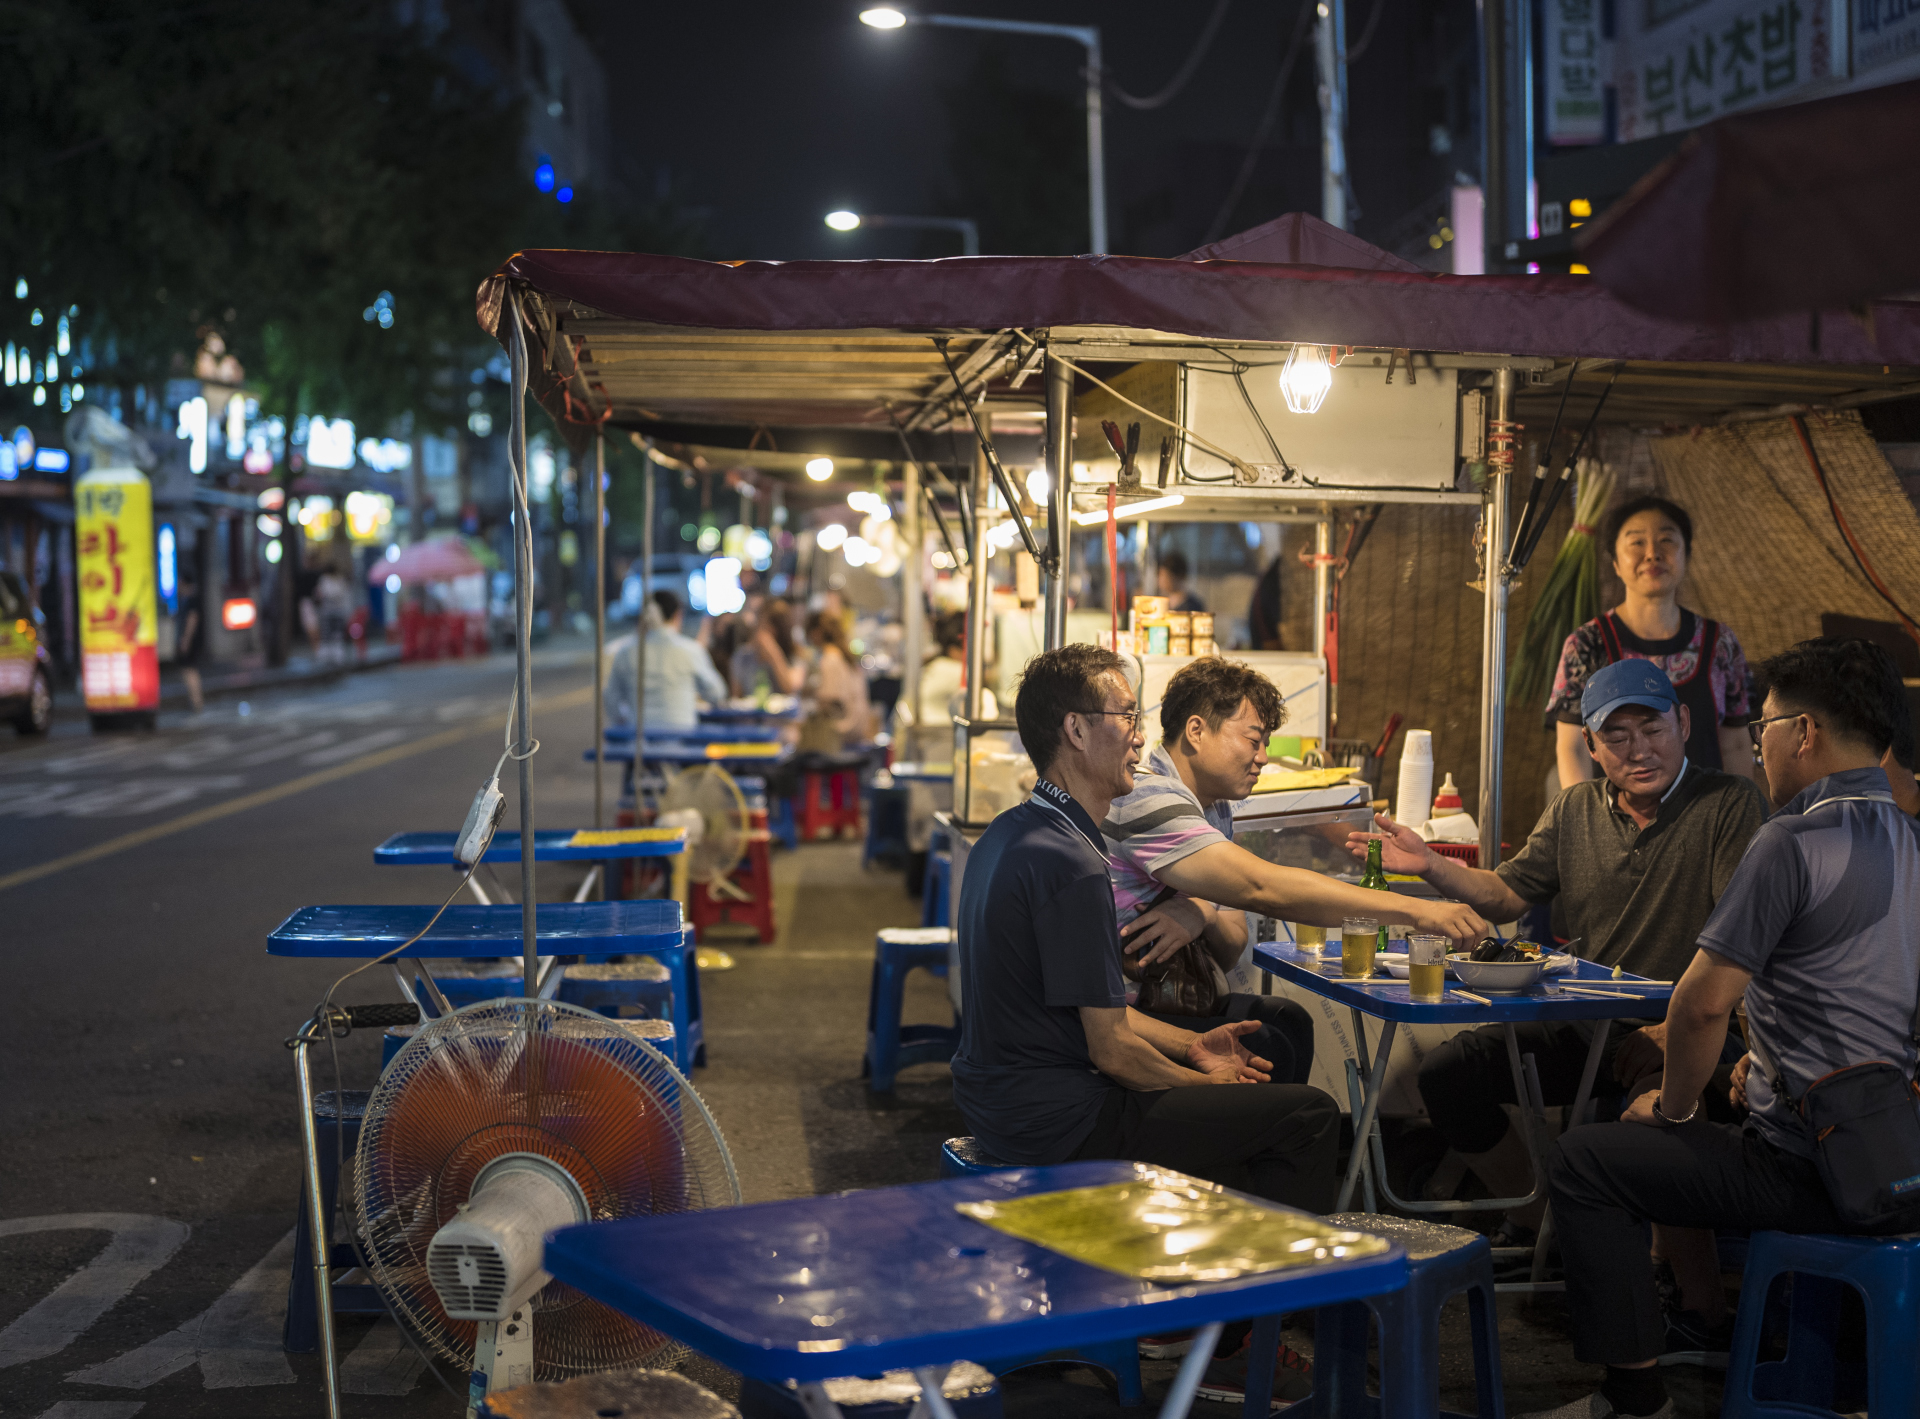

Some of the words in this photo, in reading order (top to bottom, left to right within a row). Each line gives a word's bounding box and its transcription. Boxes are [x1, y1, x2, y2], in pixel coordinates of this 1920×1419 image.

[1644, 0, 1801, 133] 부산초밥
[1320, 999, 1335, 1019] STEEL
[1331, 1019, 1354, 1057] STAINLESS
